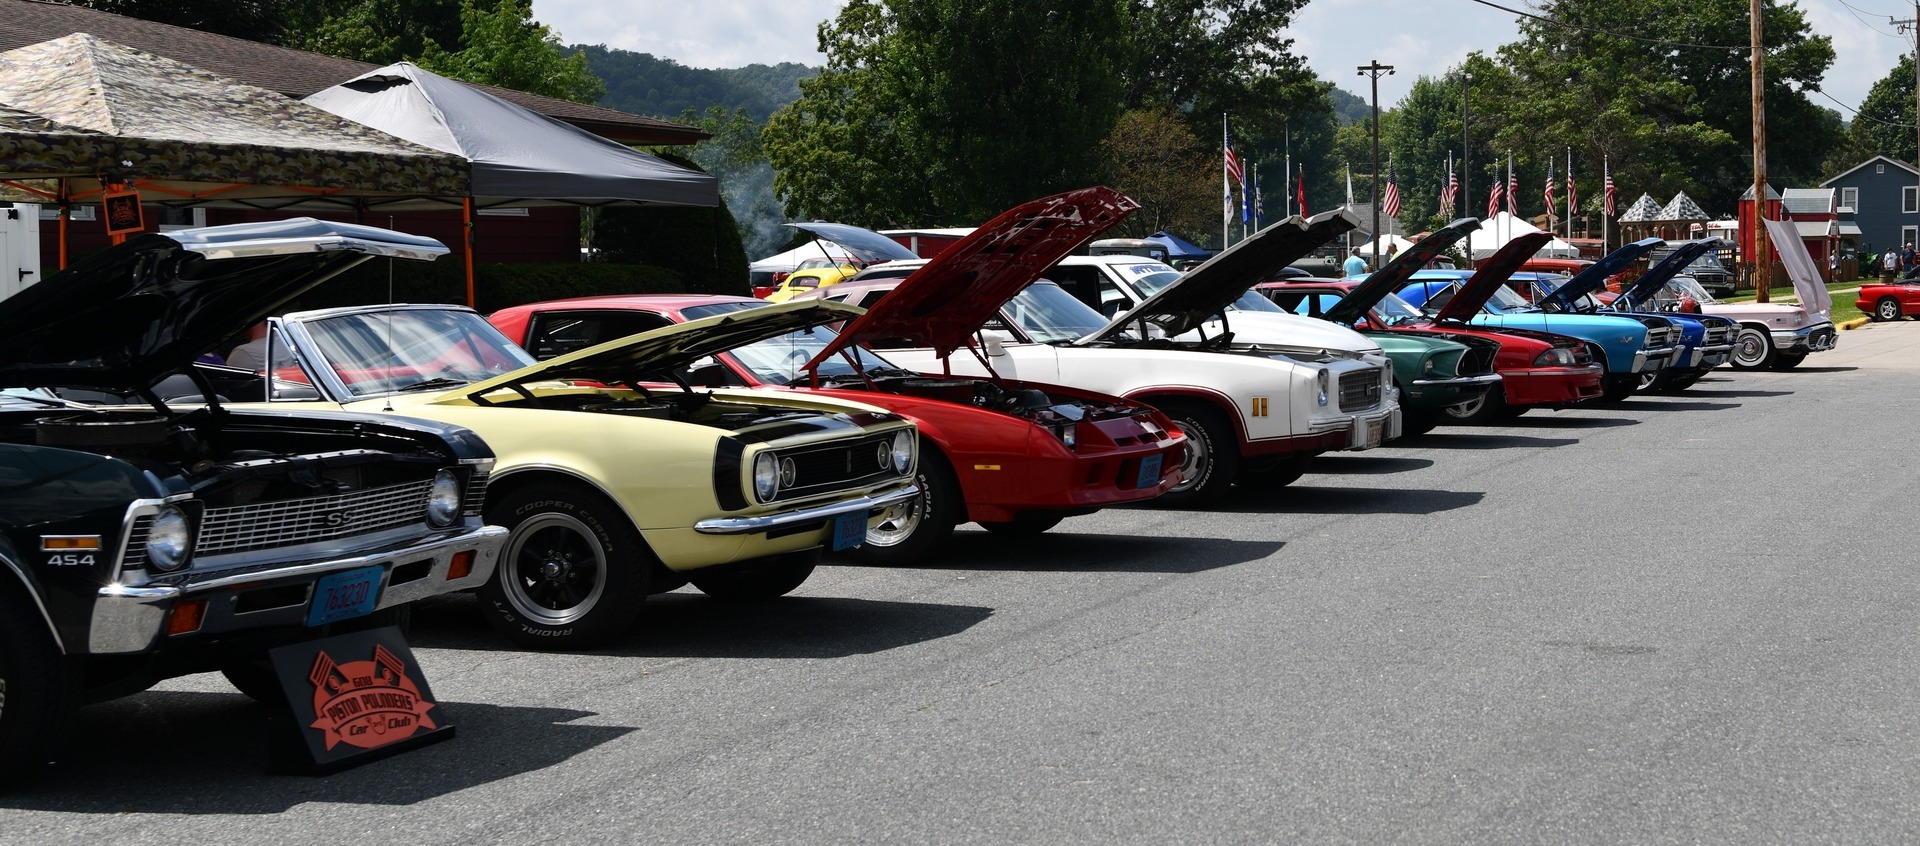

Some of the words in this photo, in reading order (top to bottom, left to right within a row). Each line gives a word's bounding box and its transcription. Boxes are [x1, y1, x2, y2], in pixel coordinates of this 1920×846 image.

[1186, 417, 1214, 453] COOPER
[1195, 458, 1214, 491] COBRA
[918, 474, 932, 520] RADIAL
[328, 510, 352, 526] SS
[516, 501, 575, 515] COOPER
[580, 510, 614, 551] COBRA
[47, 554, 96, 567] 454
[493, 600, 516, 621] G/T
[521, 623, 573, 637] RADIAL
[327, 697, 363, 724] PISTON
[360, 692, 414, 711] POUNDERS
[349, 724, 370, 736] Car
[388, 715, 412, 729] Club
